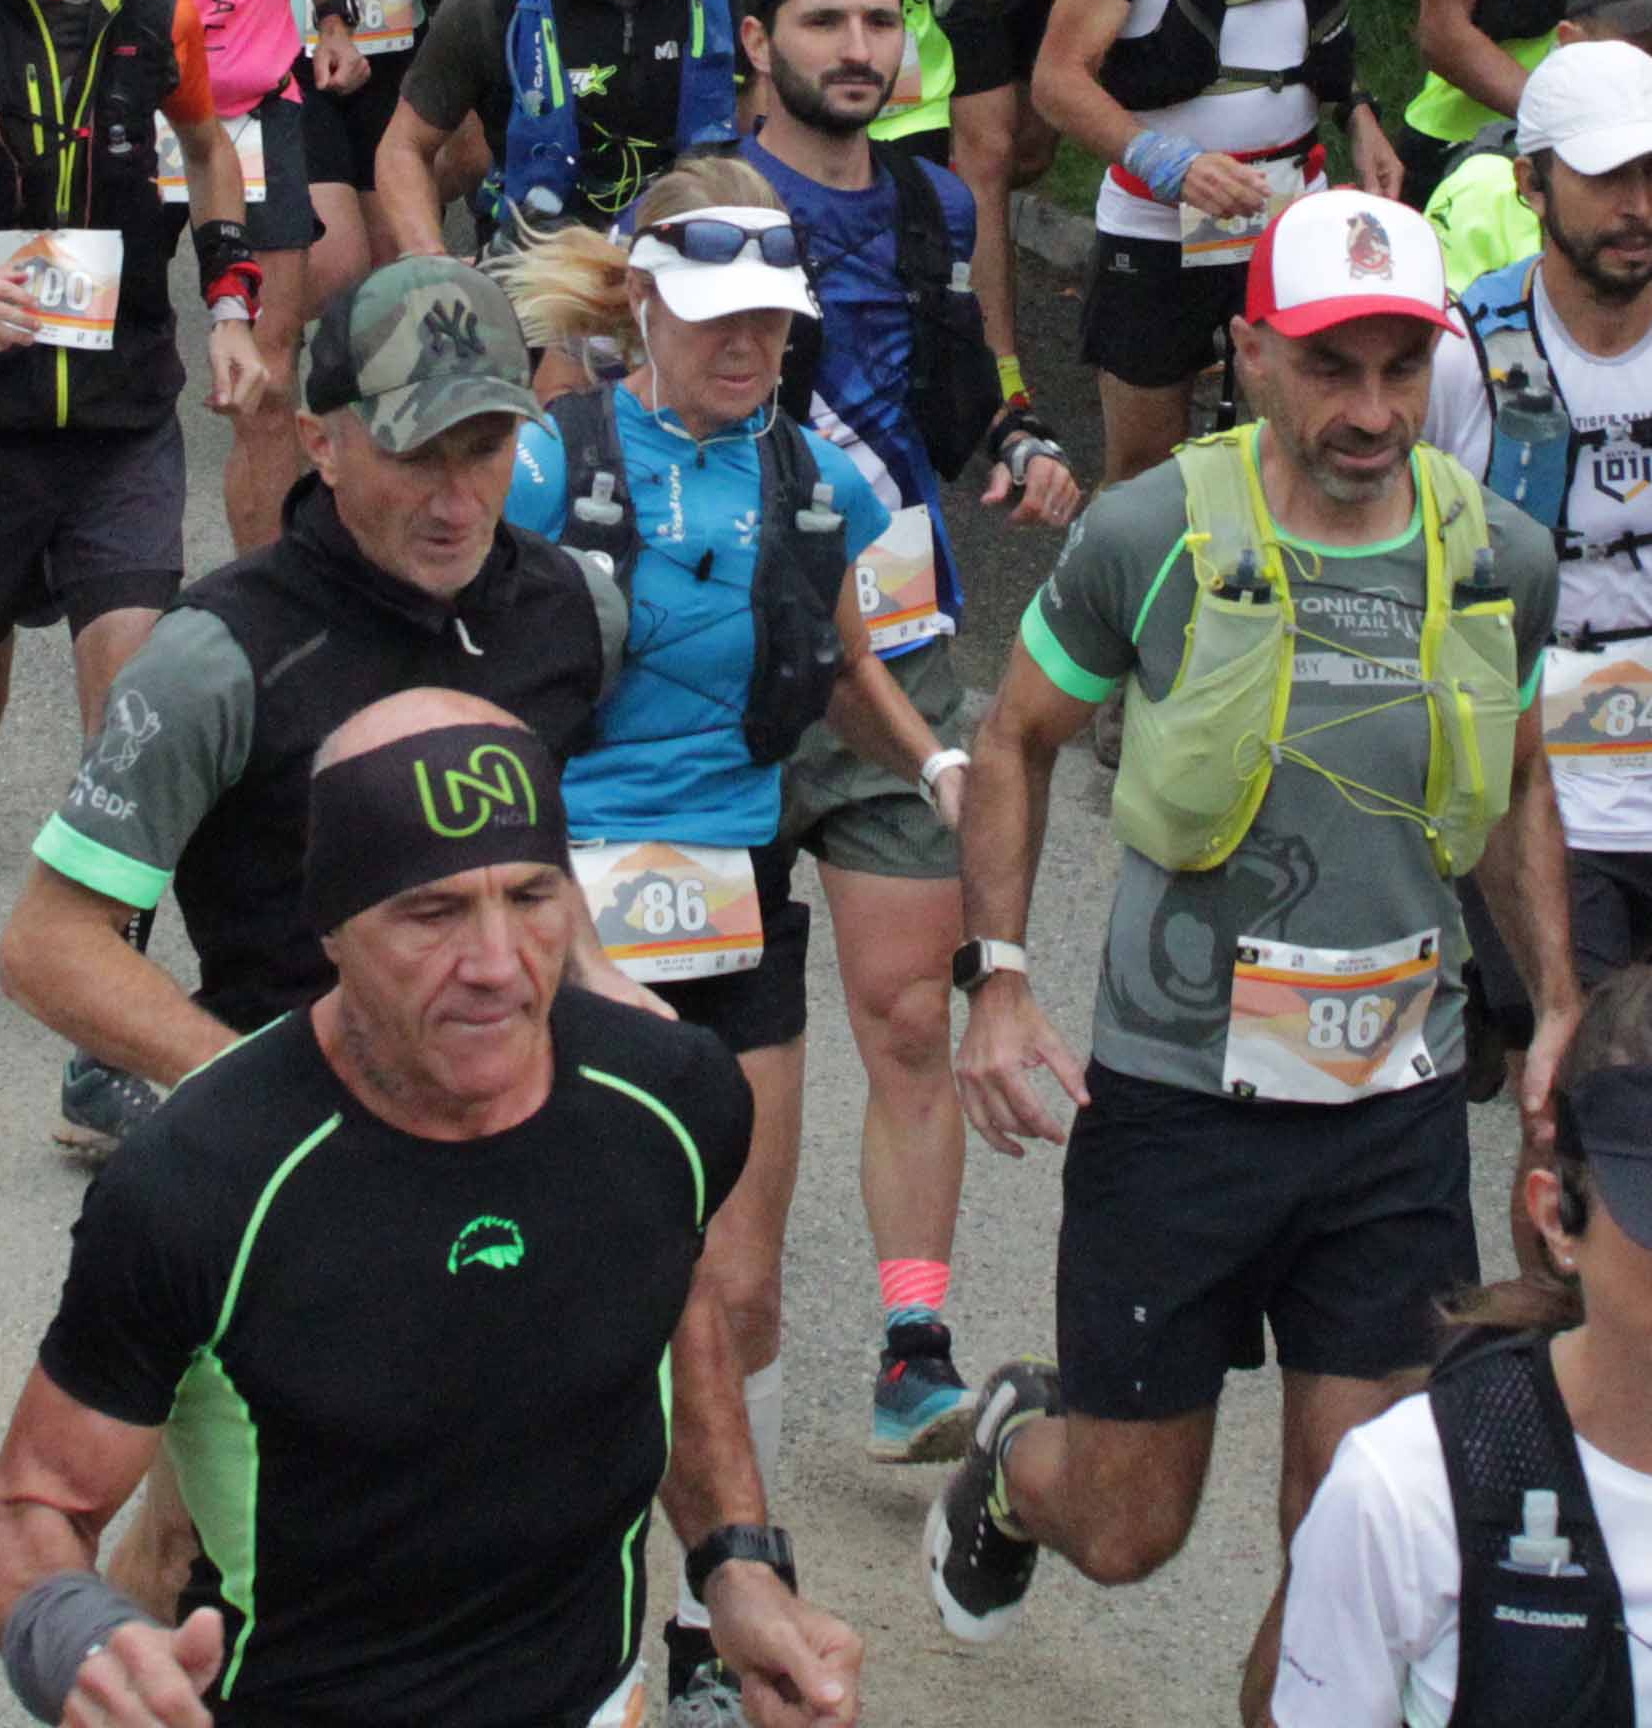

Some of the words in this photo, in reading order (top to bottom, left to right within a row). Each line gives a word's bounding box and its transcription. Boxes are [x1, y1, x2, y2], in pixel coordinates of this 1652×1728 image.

[1331, 615, 1390, 630] TRAIL
[1294, 661, 1323, 676] BY
[642, 878, 708, 934] 86
[1494, 1604, 1588, 1629] SALOMON
